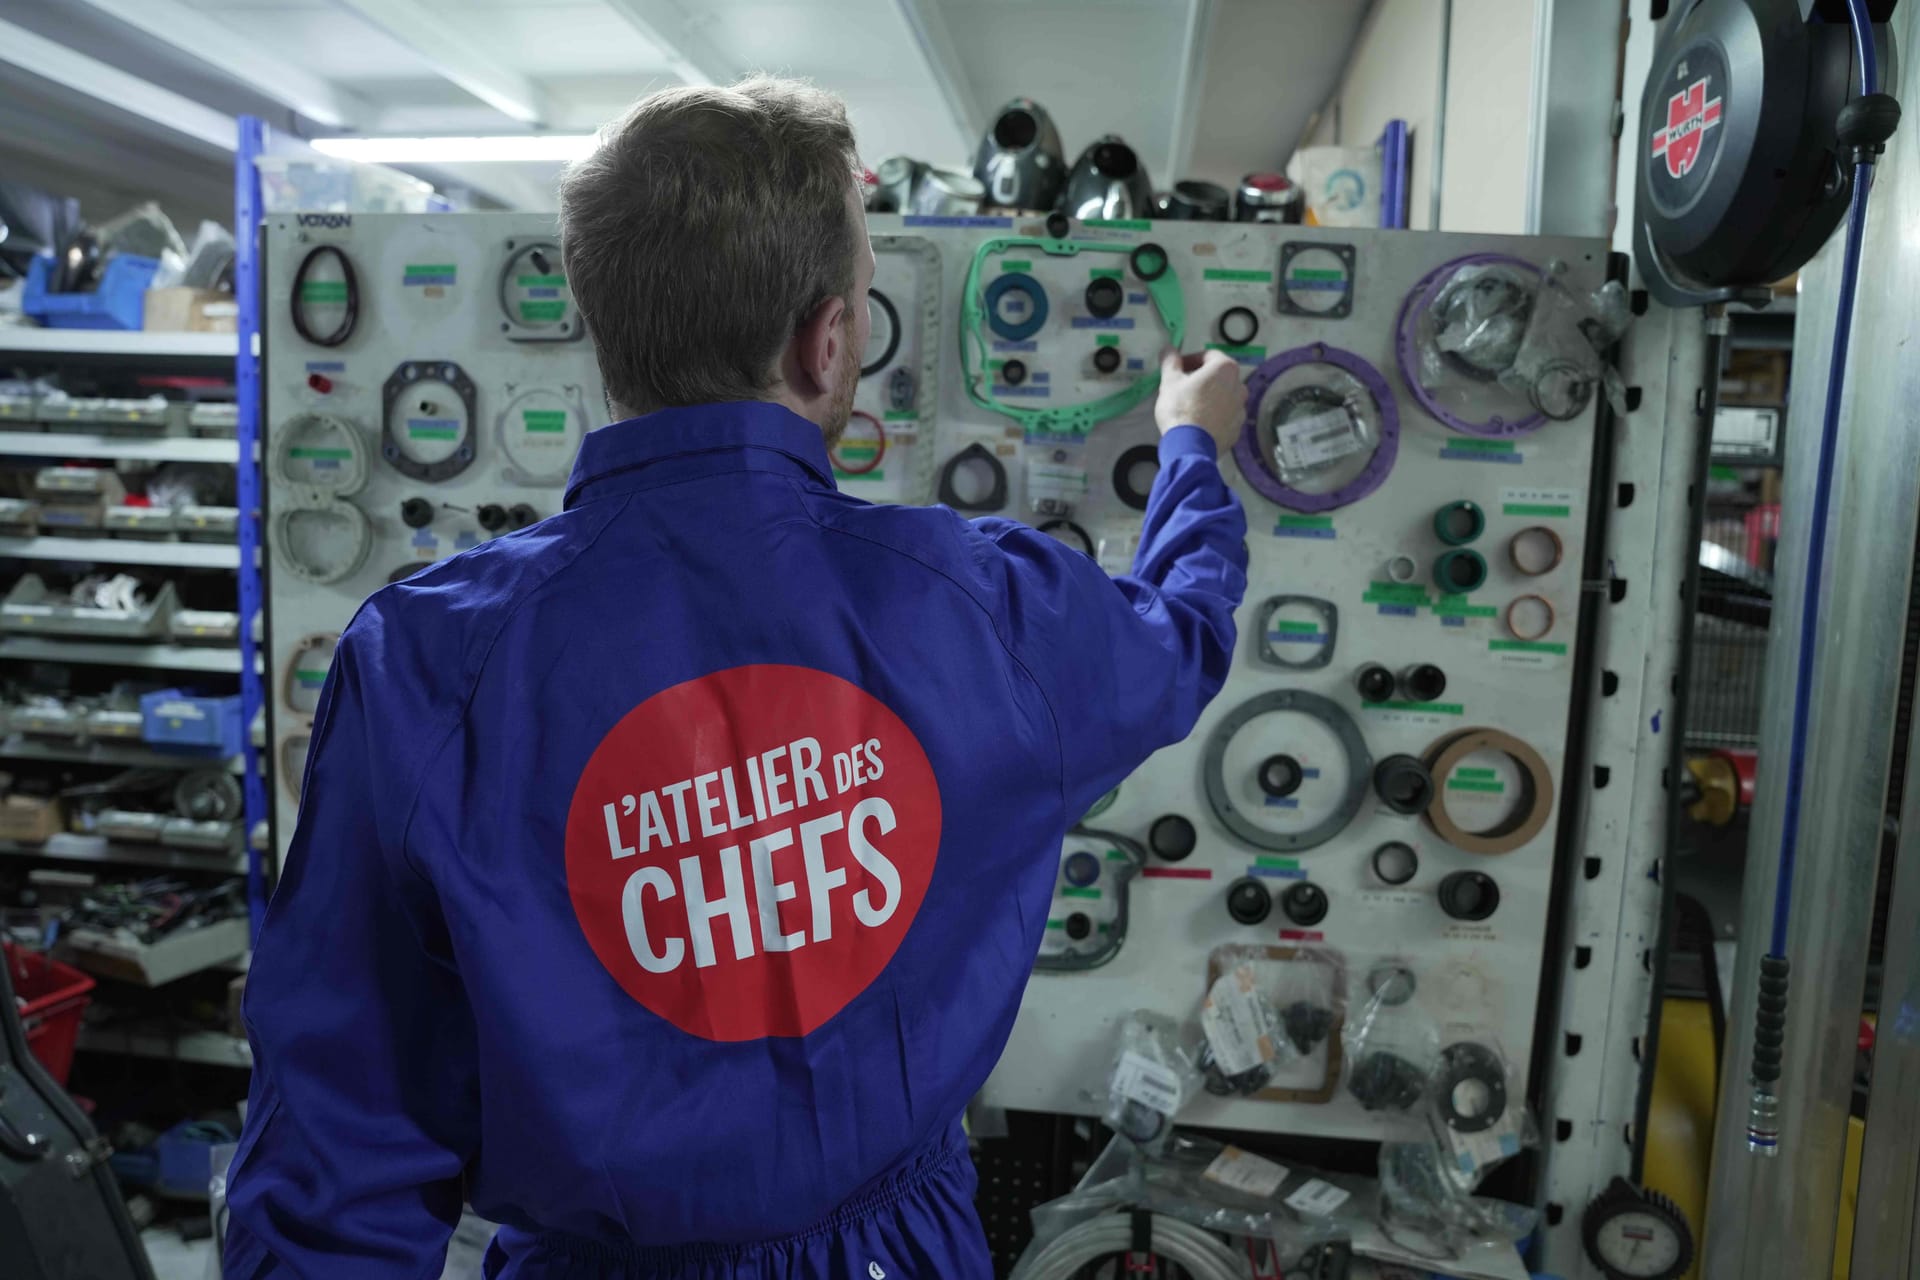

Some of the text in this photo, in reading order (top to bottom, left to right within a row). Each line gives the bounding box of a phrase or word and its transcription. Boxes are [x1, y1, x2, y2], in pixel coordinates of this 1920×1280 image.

[603, 736, 884, 860] L'ATELIER DES
[621, 796, 902, 974] CHEFS
